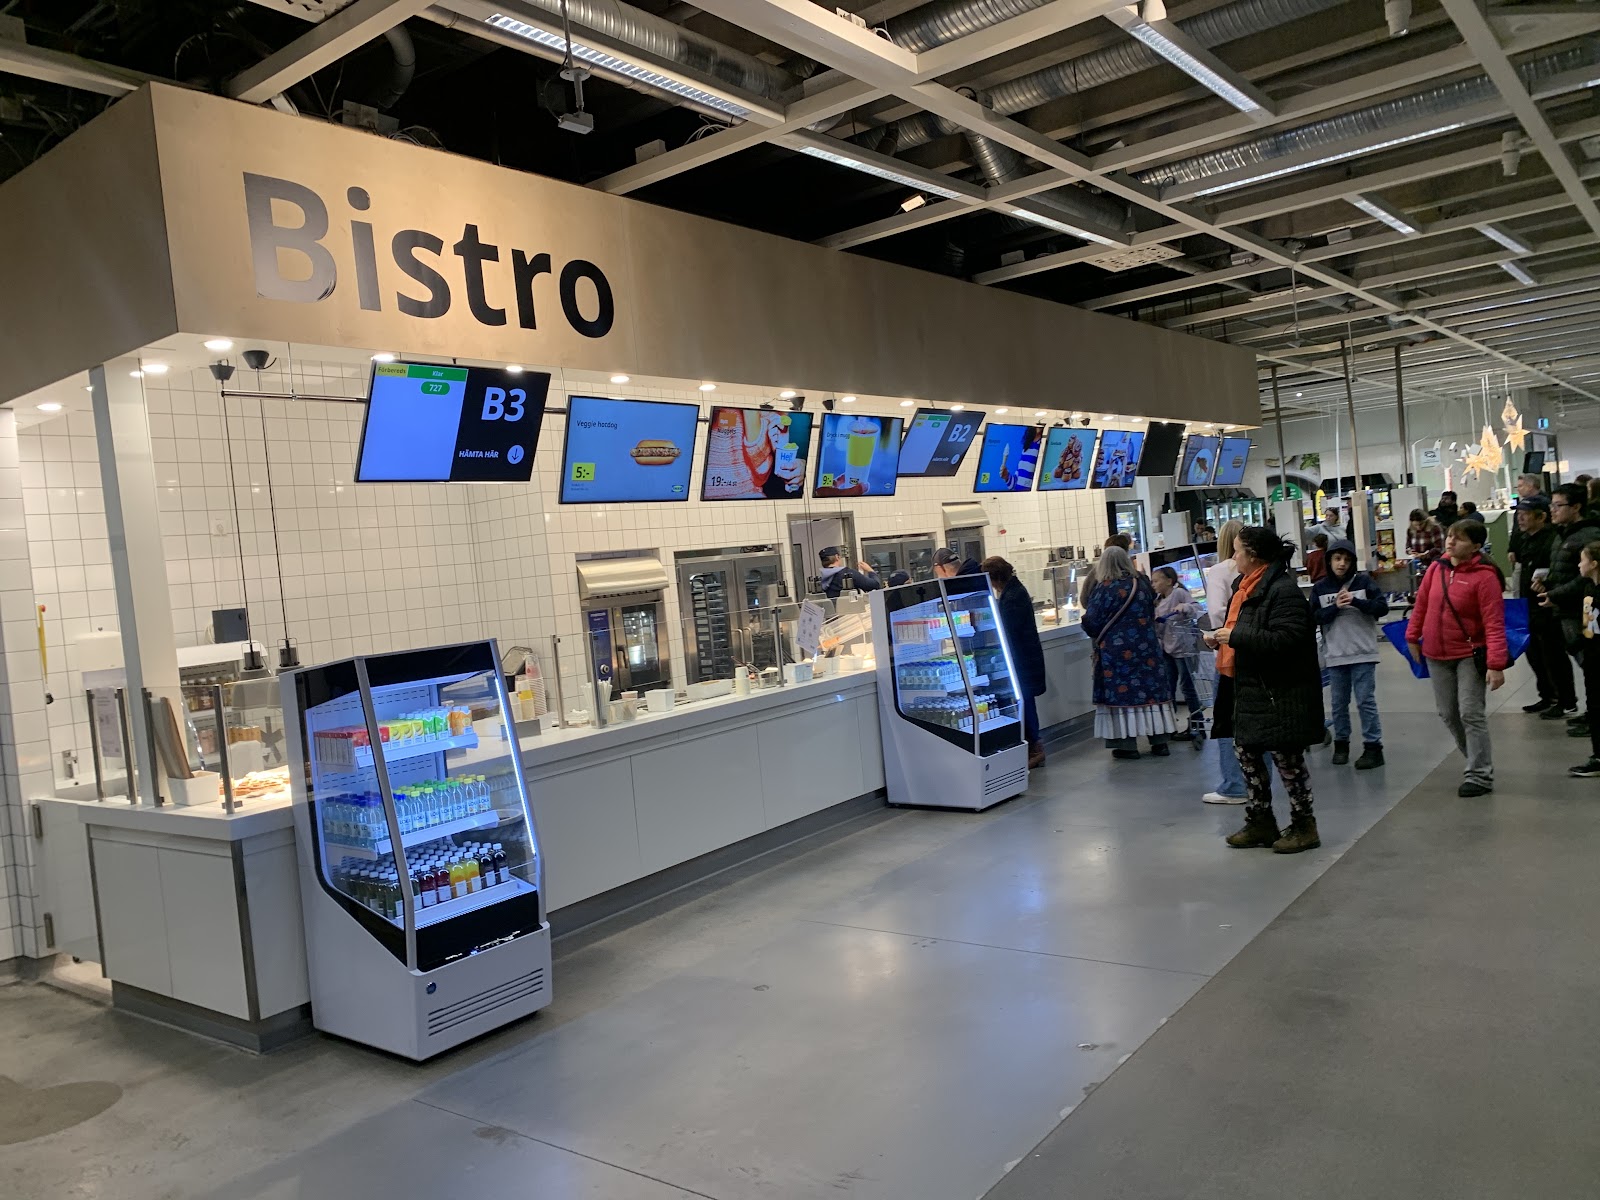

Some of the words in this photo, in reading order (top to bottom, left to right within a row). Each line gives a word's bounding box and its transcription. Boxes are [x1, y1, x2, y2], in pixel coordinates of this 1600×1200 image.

[243, 172, 614, 338] Bistro
[429, 384, 442, 392] 727
[481, 386, 526, 422] B3
[576, 420, 596, 429] Veggie
[597, 420, 617, 430] hotdog
[947, 423, 971, 442] B2
[459, 449, 483, 458] HÄMTA
[484, 449, 499, 458] HÄR
[780, 452, 793, 462] Hej!
[575, 466, 589, 478] 5:-
[823, 475, 831, 485] 9:-
